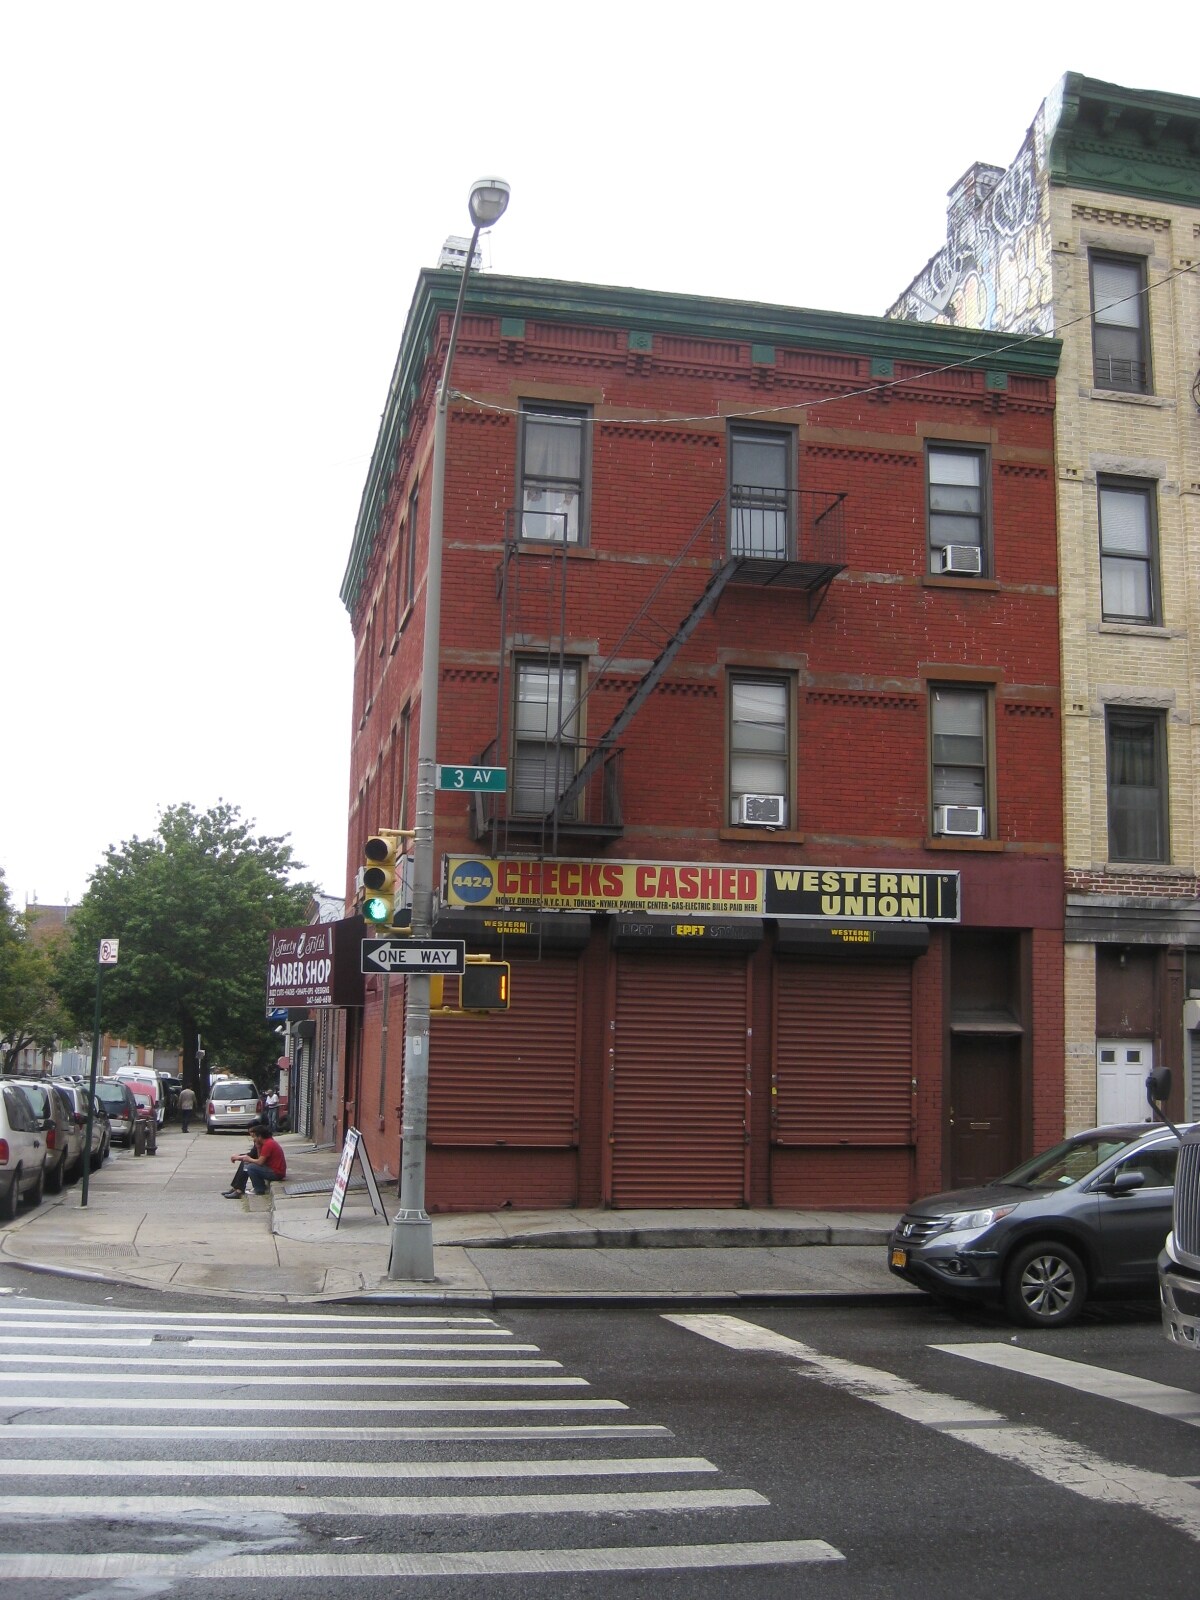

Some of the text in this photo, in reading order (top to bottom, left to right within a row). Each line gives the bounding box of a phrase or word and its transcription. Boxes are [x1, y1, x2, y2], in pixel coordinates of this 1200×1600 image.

[454, 770, 491, 788] 3 AV
[453, 876, 492, 887] 4424
[497, 861, 757, 900] CHECKS CASHED
[774, 871, 920, 894] WESTERN
[495, 897, 516, 905] MONEY
[517, 897, 540, 906] ORDERS
[574, 899, 595, 908] TOKENS
[600, 900, 617, 909] NYNEX
[619, 901, 645, 910] PAYMENT
[647, 901, 668, 910] CENTER
[671, 902, 710, 911] GAS-ELECTRIC
[712, 902, 728, 911] BILLS
[729, 903, 742, 912] PAID
[744, 903, 757, 912] HERE
[821, 895, 920, 917] UNION
[484, 920, 526, 928] WESTERN
[275, 934, 325, 957] Forty Fifth
[378, 950, 451, 963] ONE WAY
[270, 958, 331, 987] BARBER SHOP
